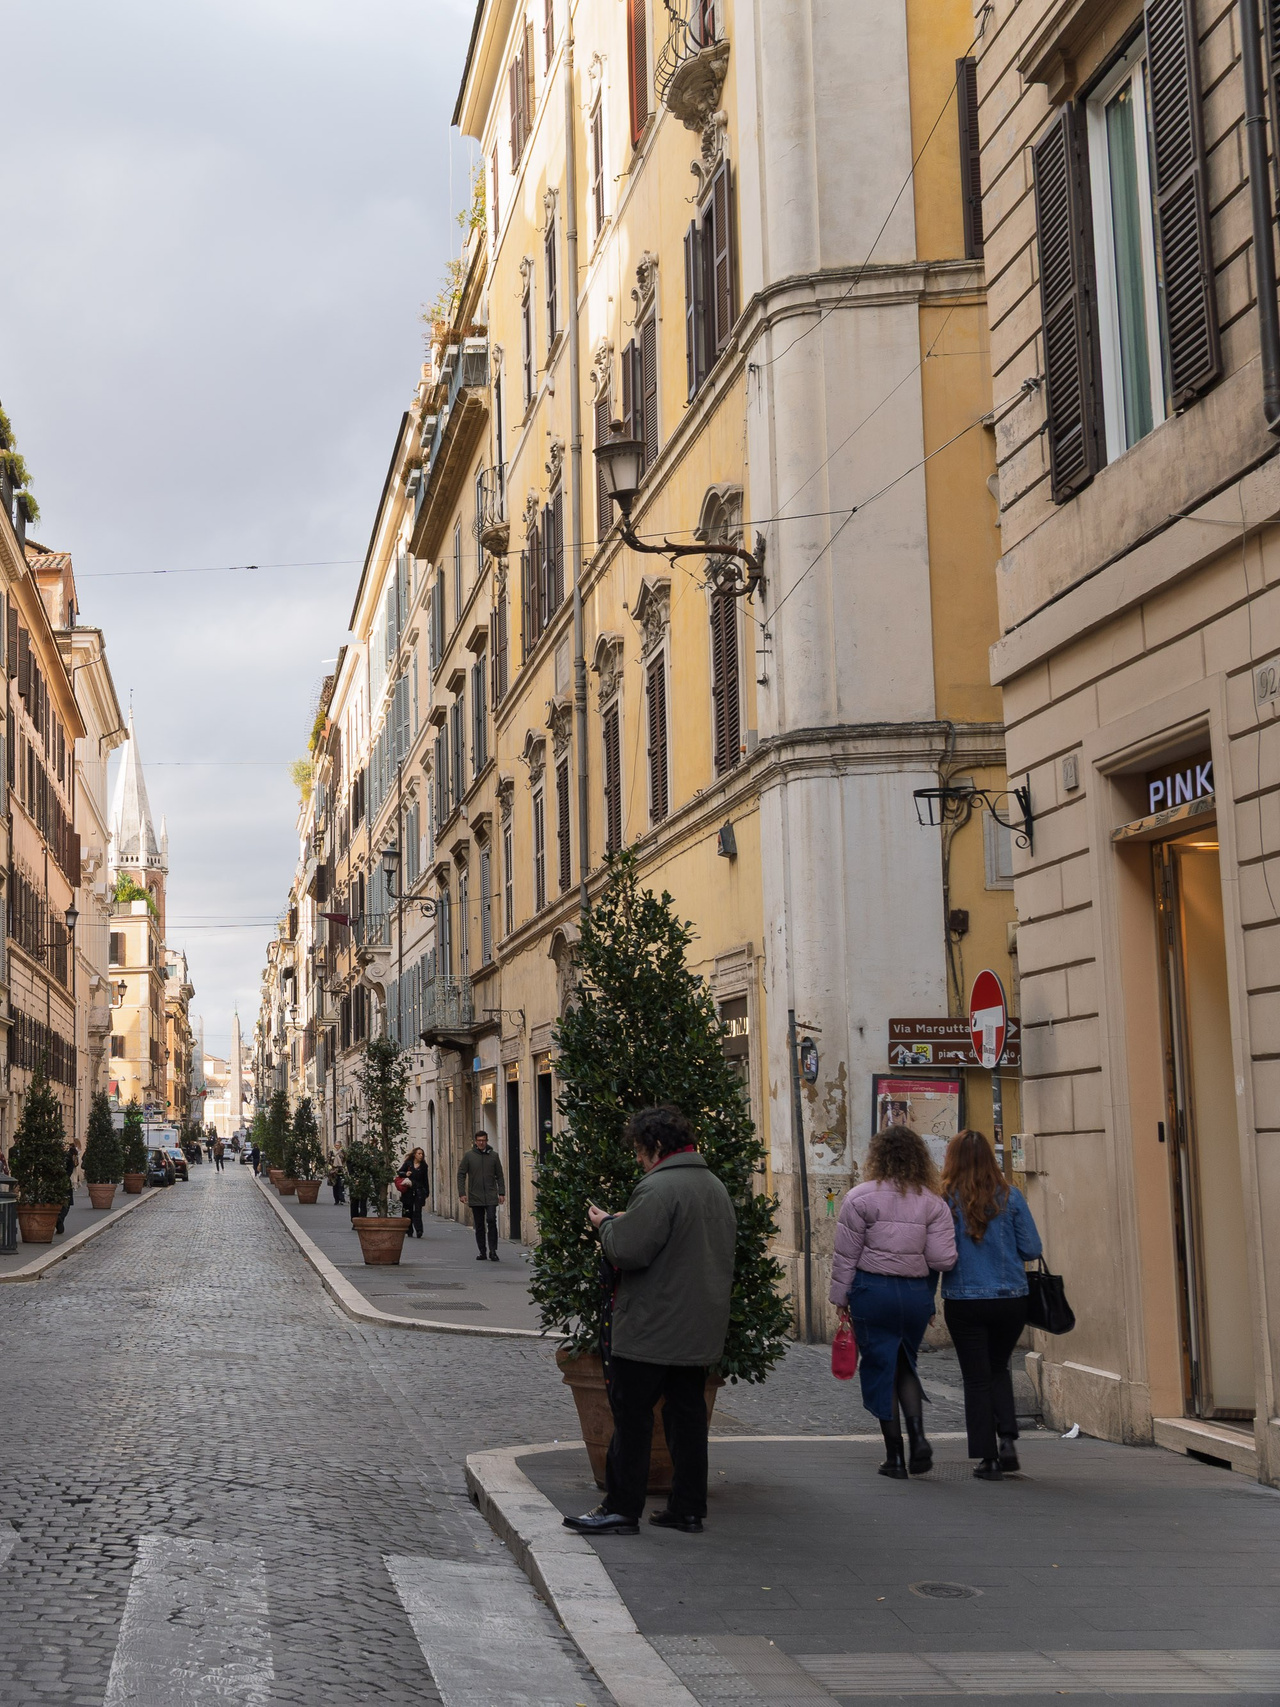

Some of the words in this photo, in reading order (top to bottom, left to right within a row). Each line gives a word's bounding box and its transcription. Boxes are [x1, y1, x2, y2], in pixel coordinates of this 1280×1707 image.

[1260, 667, 1280, 698] 92
[1149, 760, 1214, 814] PINK
[893, 1024, 911, 1034] Via
[916, 1024, 971, 1035] Margutta
